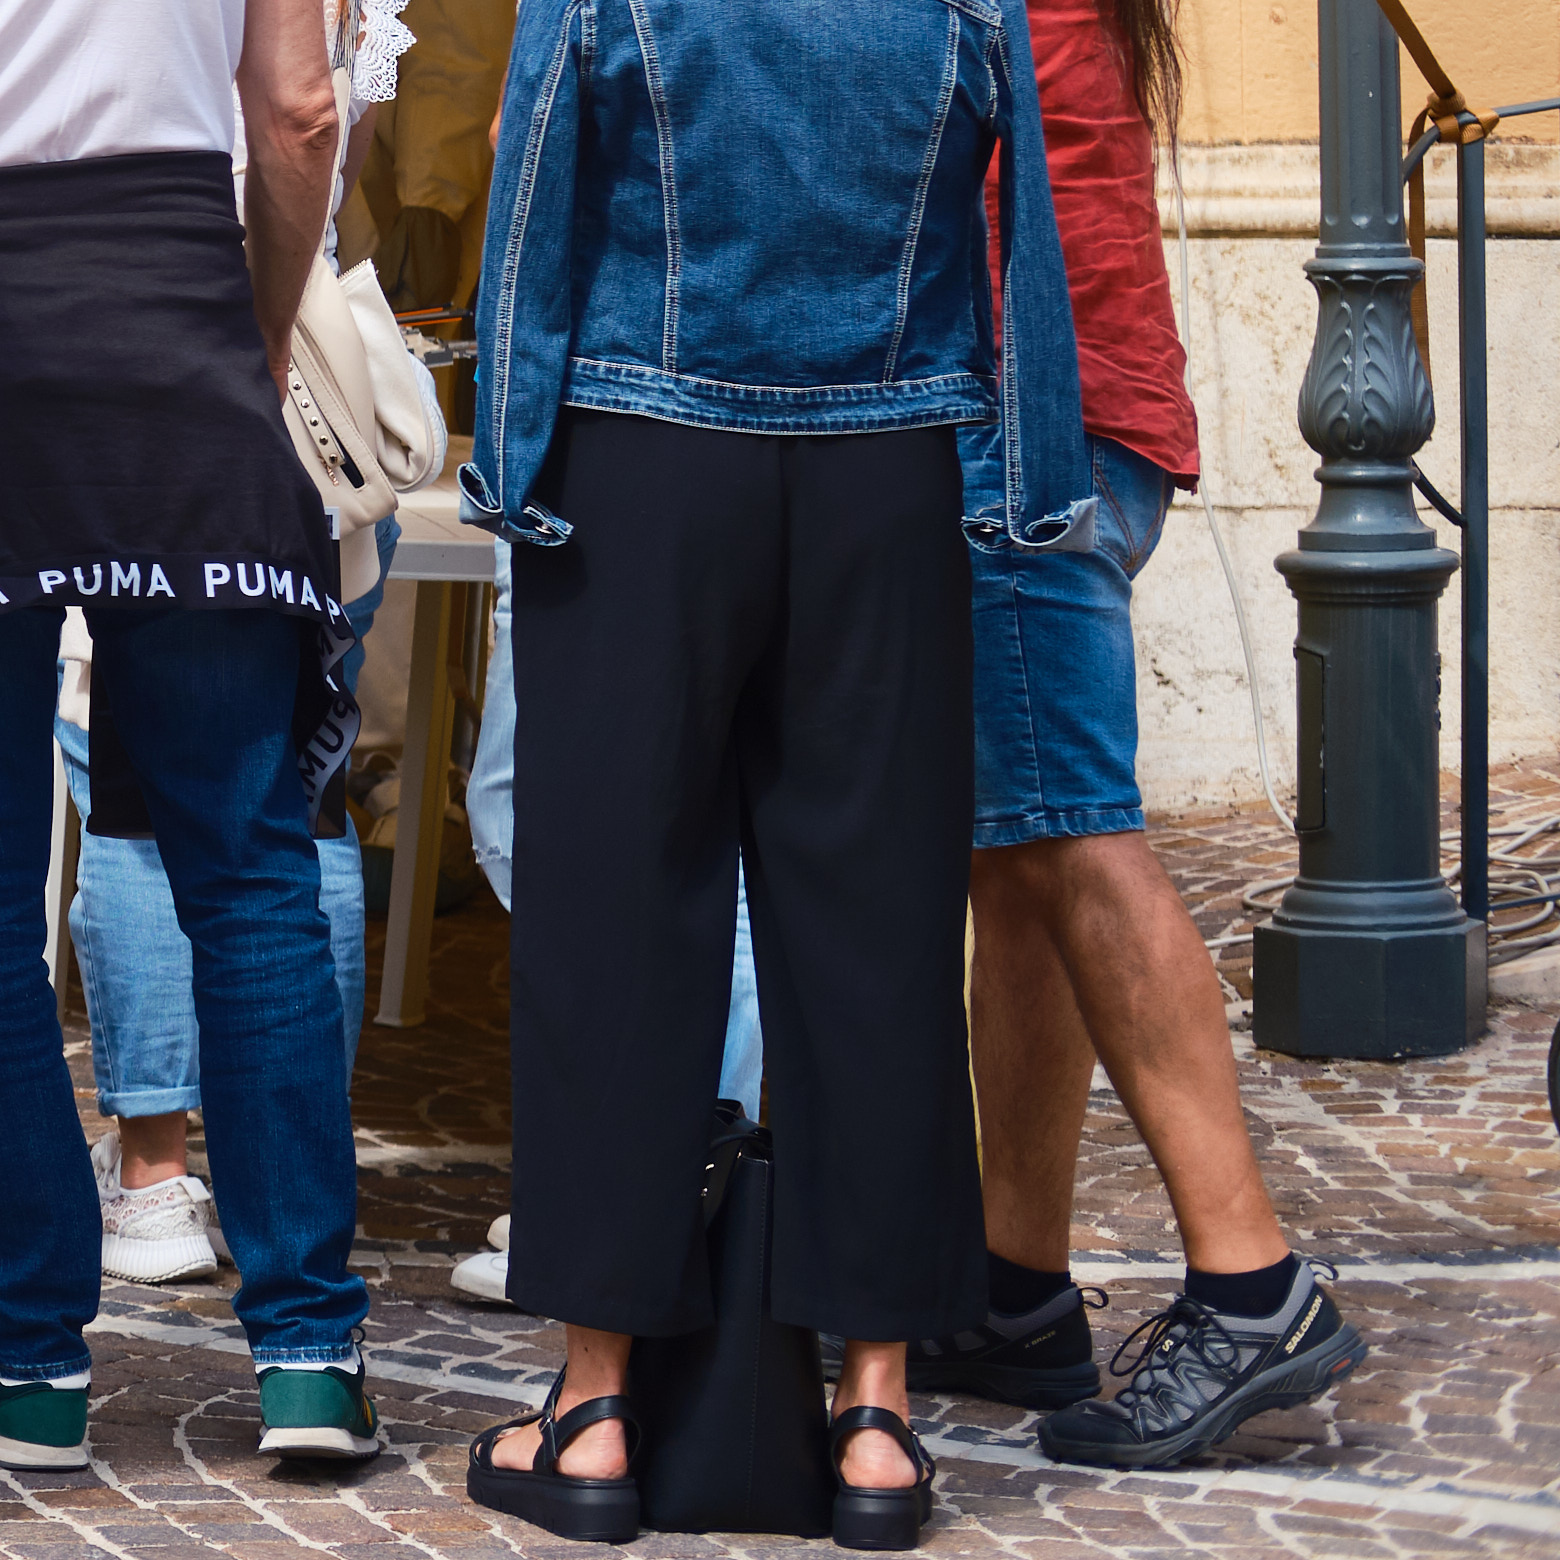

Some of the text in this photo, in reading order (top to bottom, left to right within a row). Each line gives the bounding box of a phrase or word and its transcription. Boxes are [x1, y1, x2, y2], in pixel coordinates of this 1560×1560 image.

[38, 561, 176, 598] PUMA
[203, 562, 322, 612] PUMA
[1284, 1294, 1323, 1354] SALOMON
